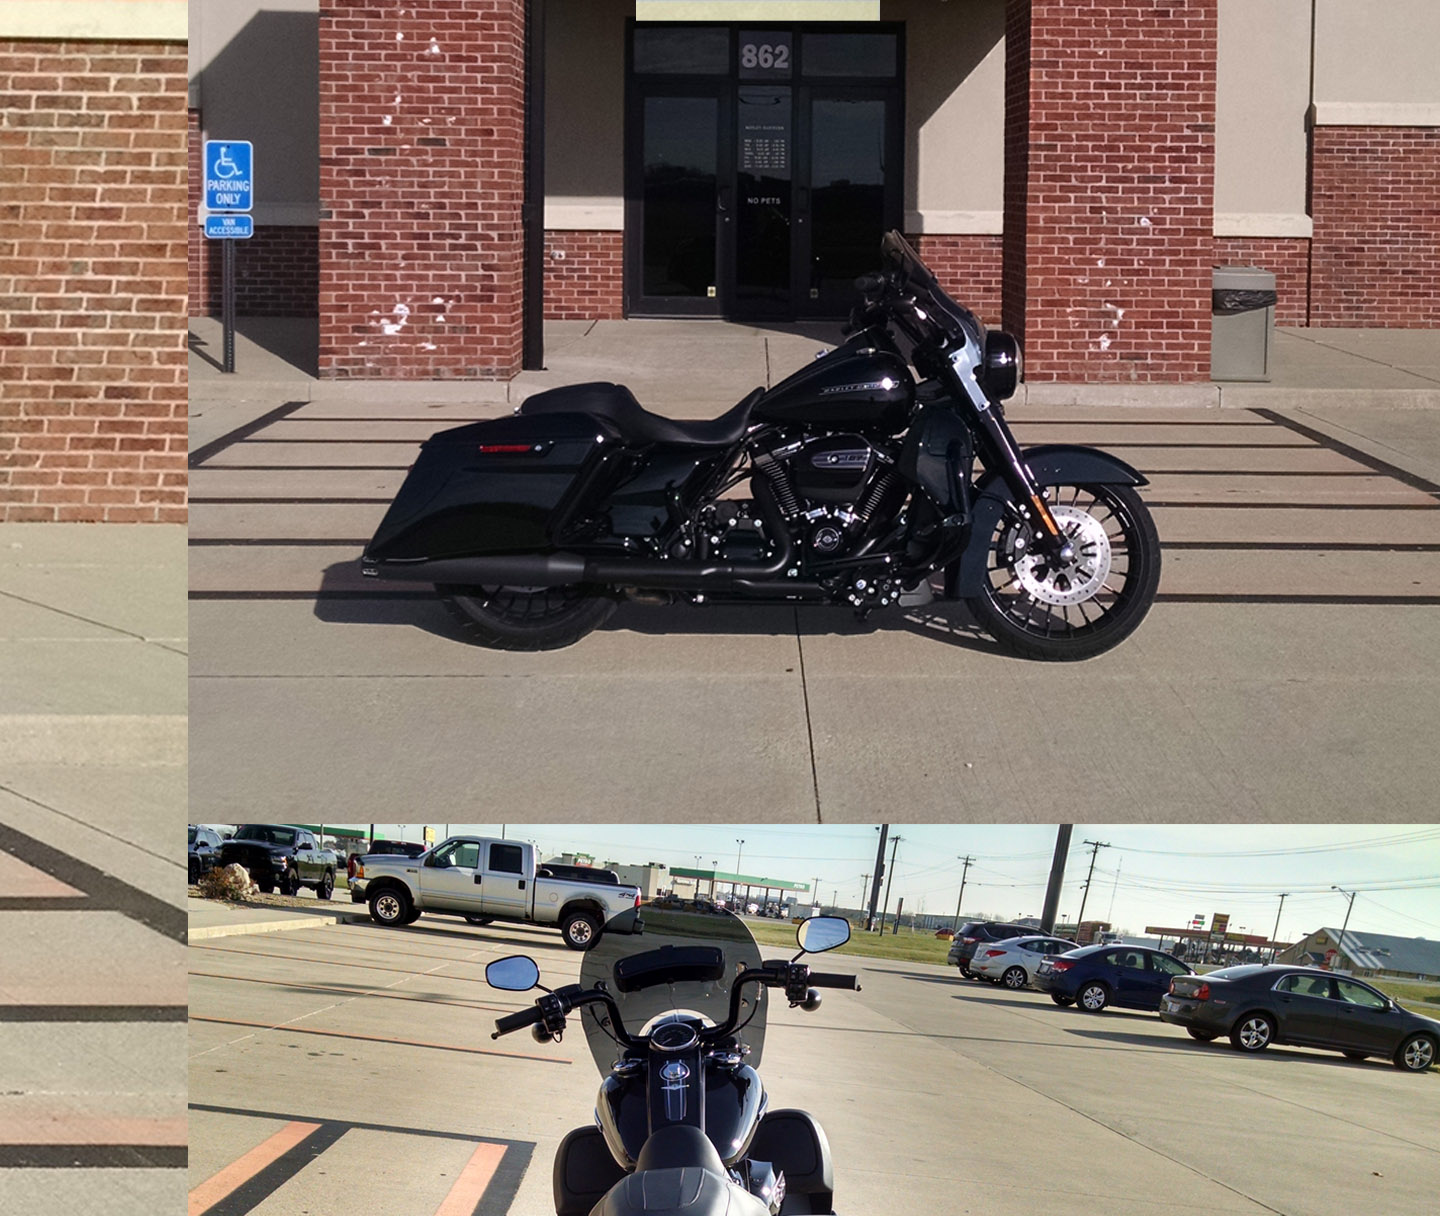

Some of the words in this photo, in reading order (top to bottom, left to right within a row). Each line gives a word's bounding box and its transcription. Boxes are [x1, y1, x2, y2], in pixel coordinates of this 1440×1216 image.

[741, 44, 789, 69] 862
[207, 180, 250, 192] PARKING
[215, 193, 241, 205] ONLY
[747, 197, 759, 205] NO
[761, 197, 781, 205] PETS
[209, 226, 249, 235] ACCESSIBLE
